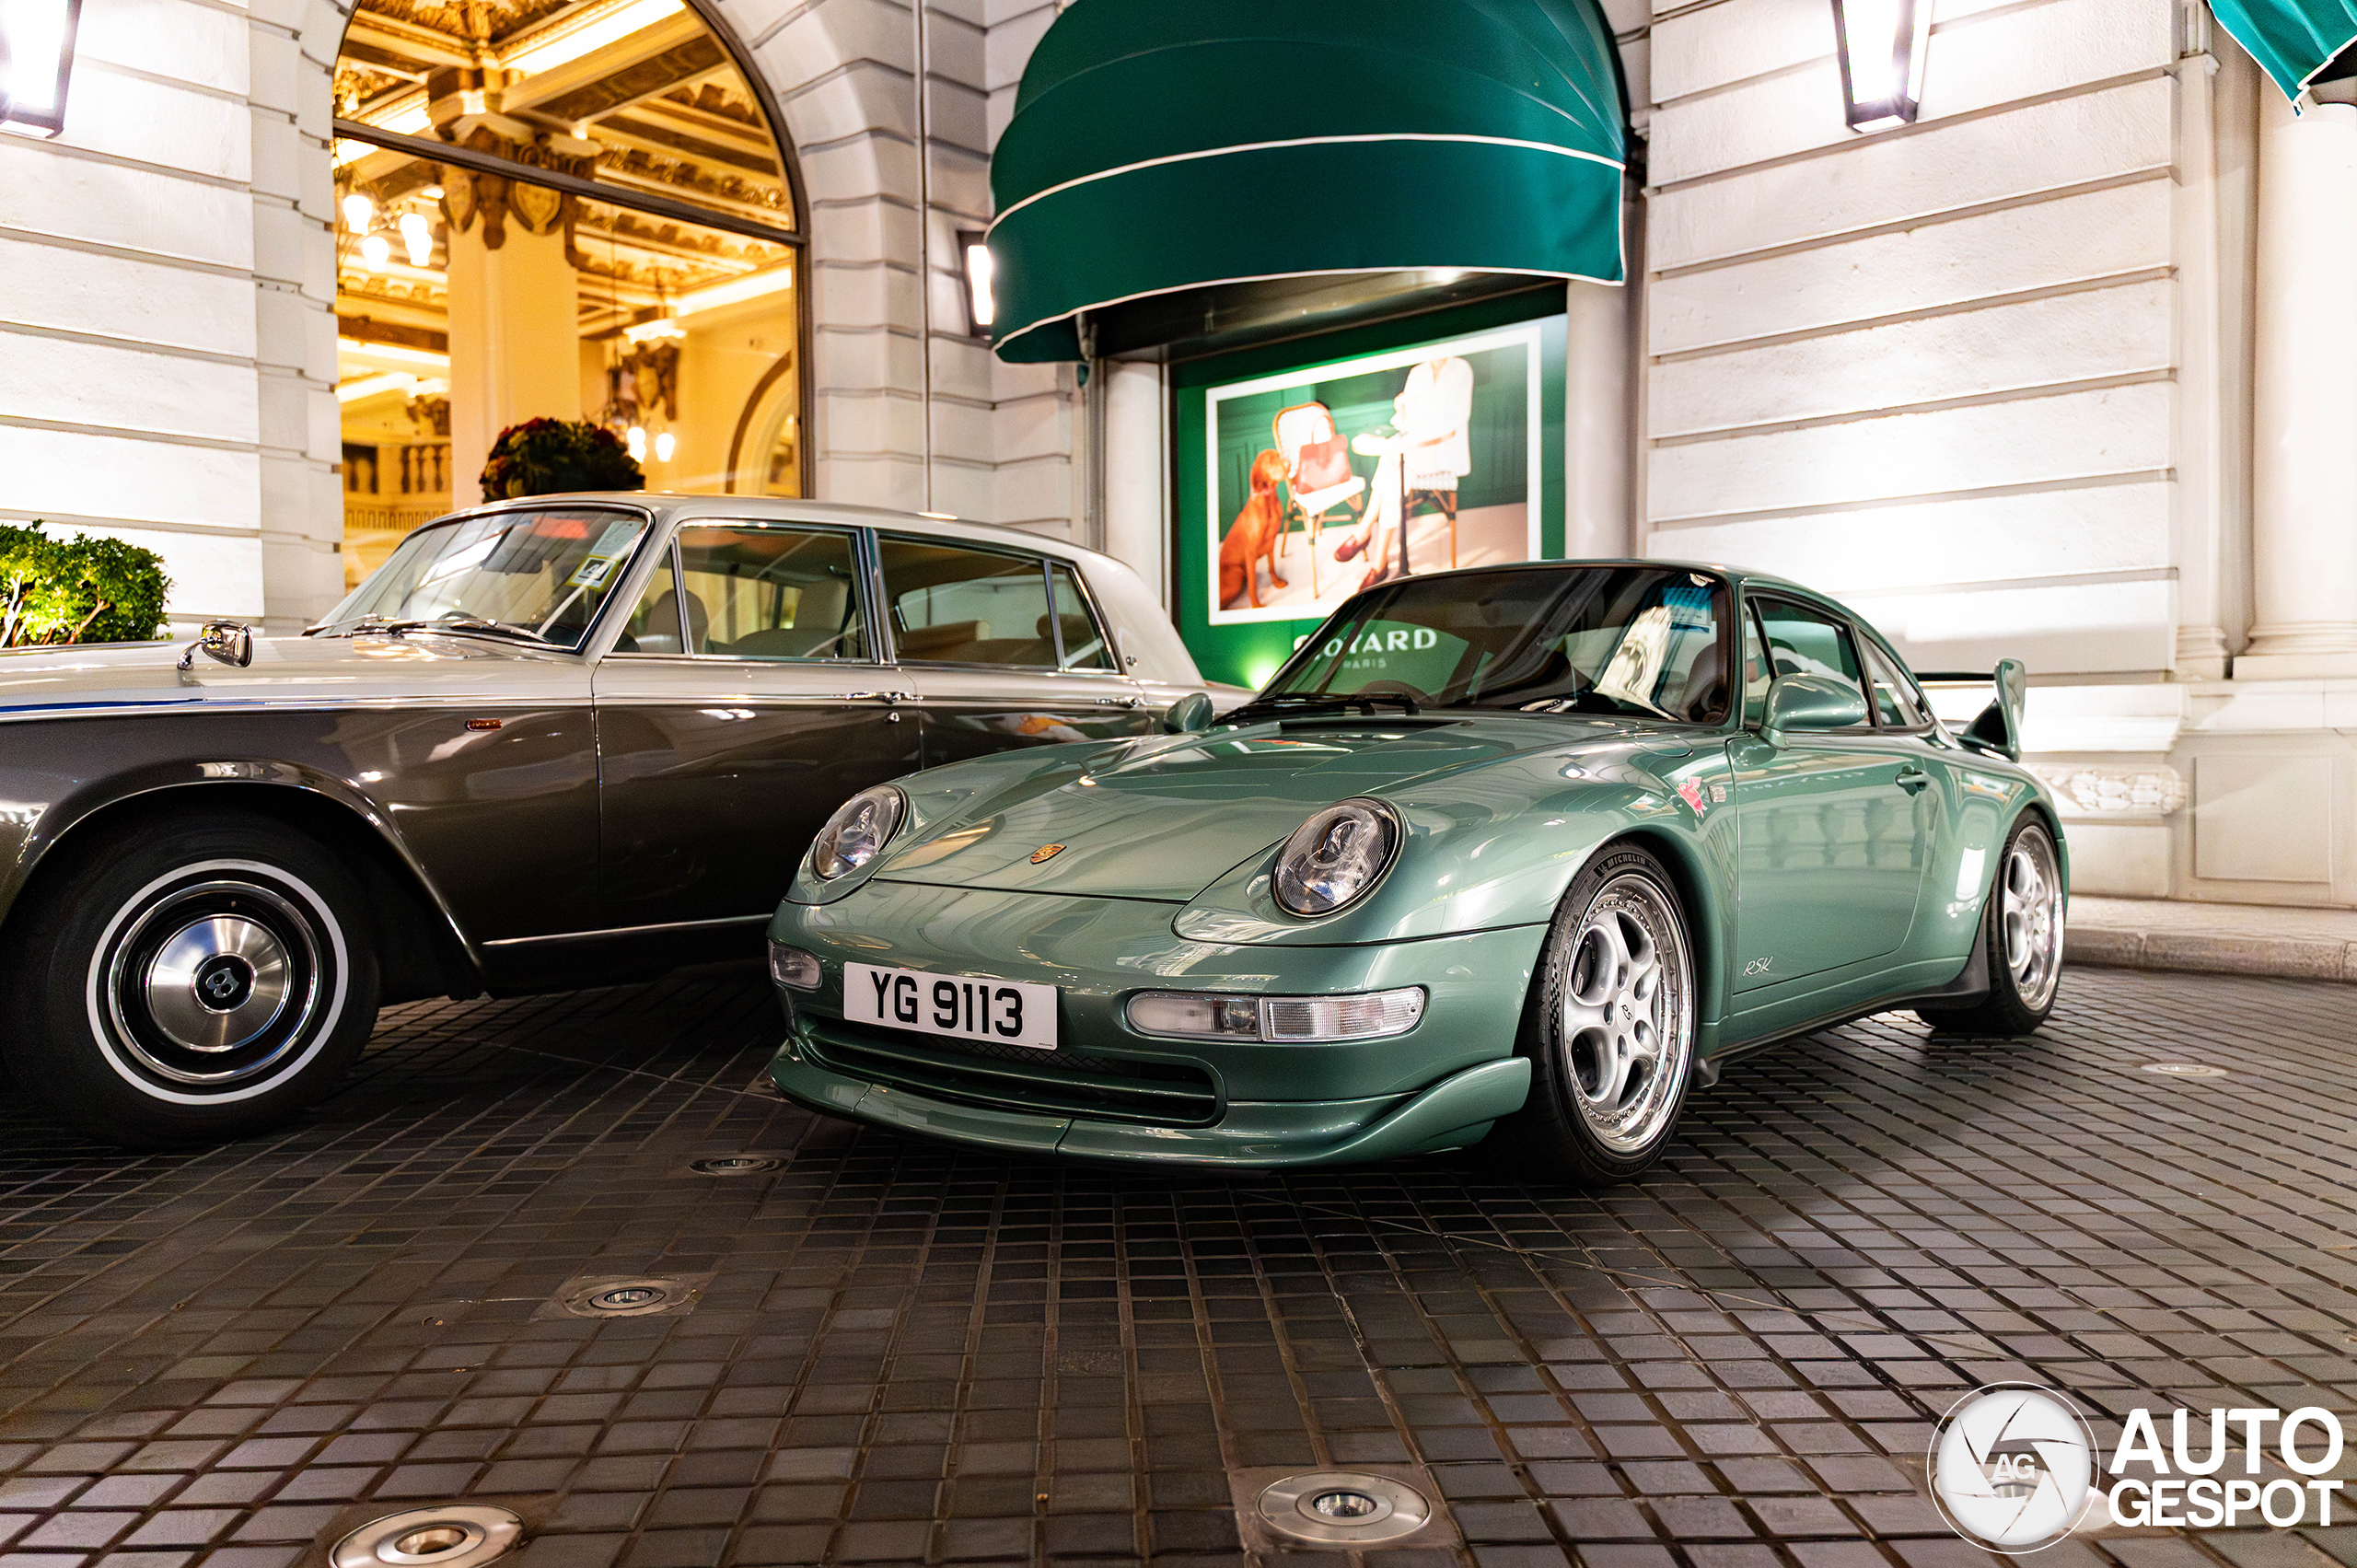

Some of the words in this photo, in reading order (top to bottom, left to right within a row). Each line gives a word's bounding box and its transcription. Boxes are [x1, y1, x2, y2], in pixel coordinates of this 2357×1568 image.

[1607, 853, 1646, 869] MICHELIN
[1742, 955, 1774, 977] RSK
[869, 970, 919, 1025] YG
[932, 980, 1024, 1039] 9113
[1620, 1004, 1633, 1021] RS
